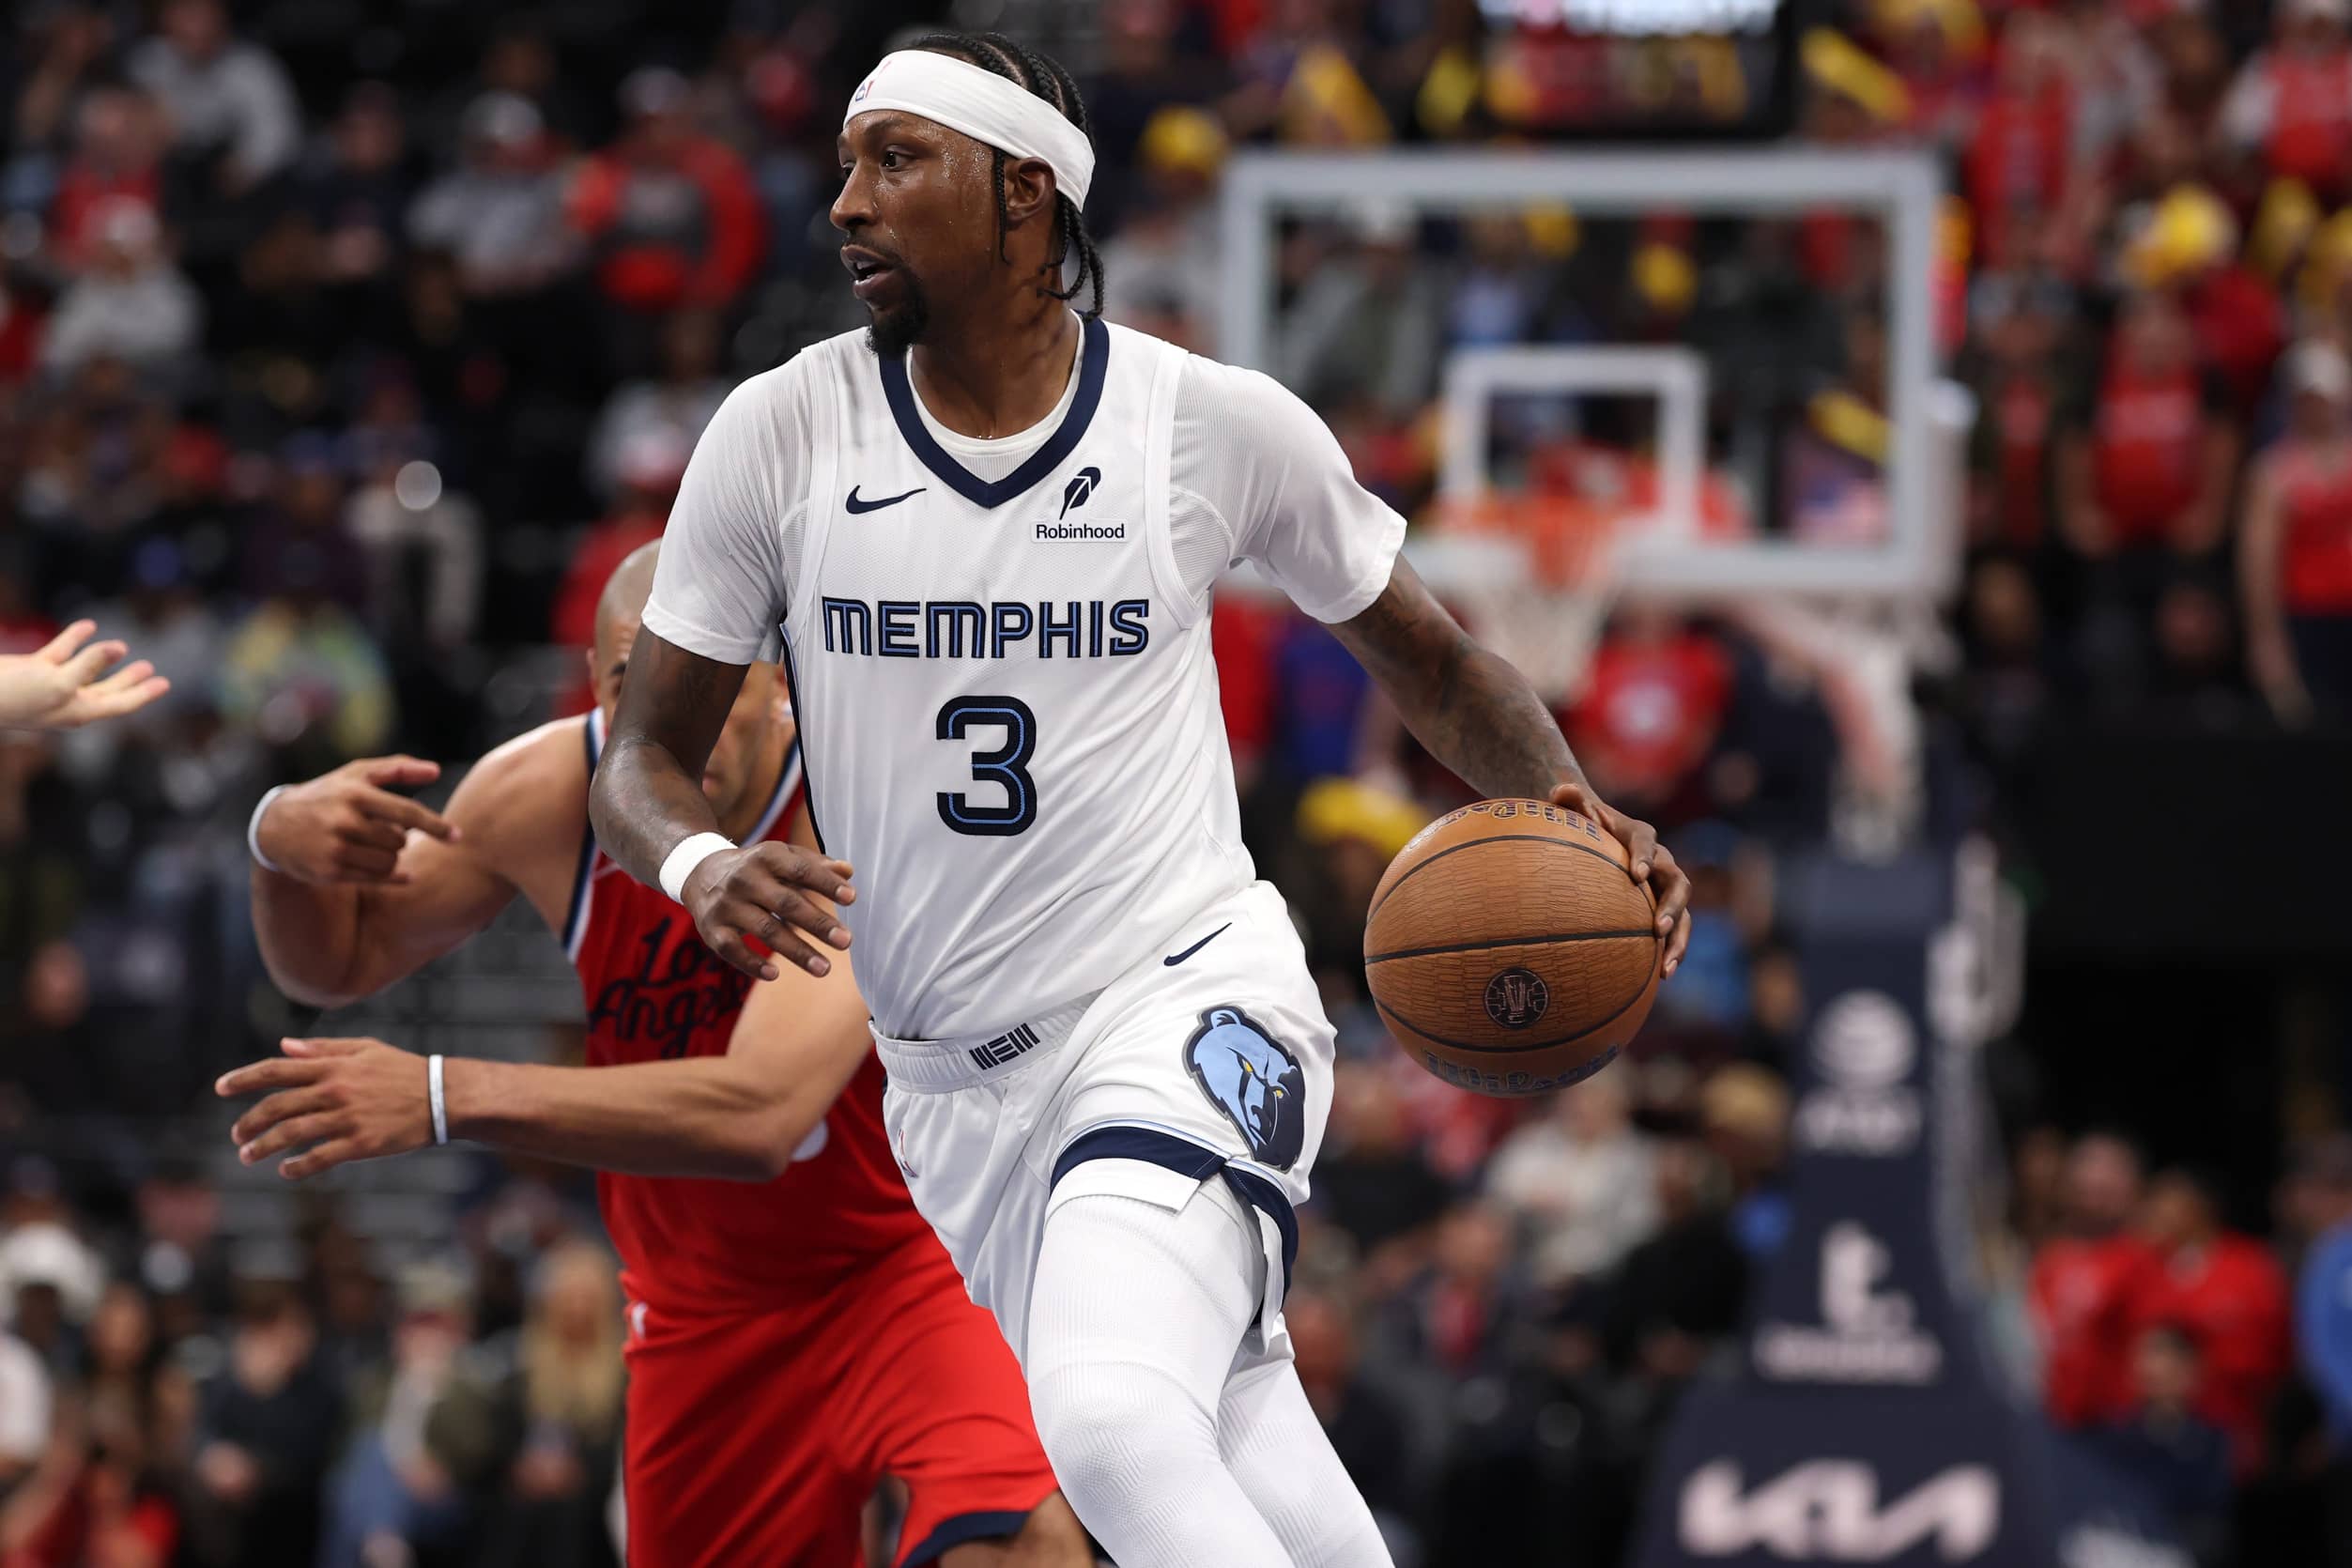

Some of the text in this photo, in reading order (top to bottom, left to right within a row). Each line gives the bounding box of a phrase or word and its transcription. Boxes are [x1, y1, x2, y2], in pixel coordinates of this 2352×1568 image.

[1035, 523, 1126, 540] Robinhood
[822, 596, 1150, 659] MEMPHIS
[936, 696, 1038, 837] 3
[586, 970, 753, 1058] Angel
